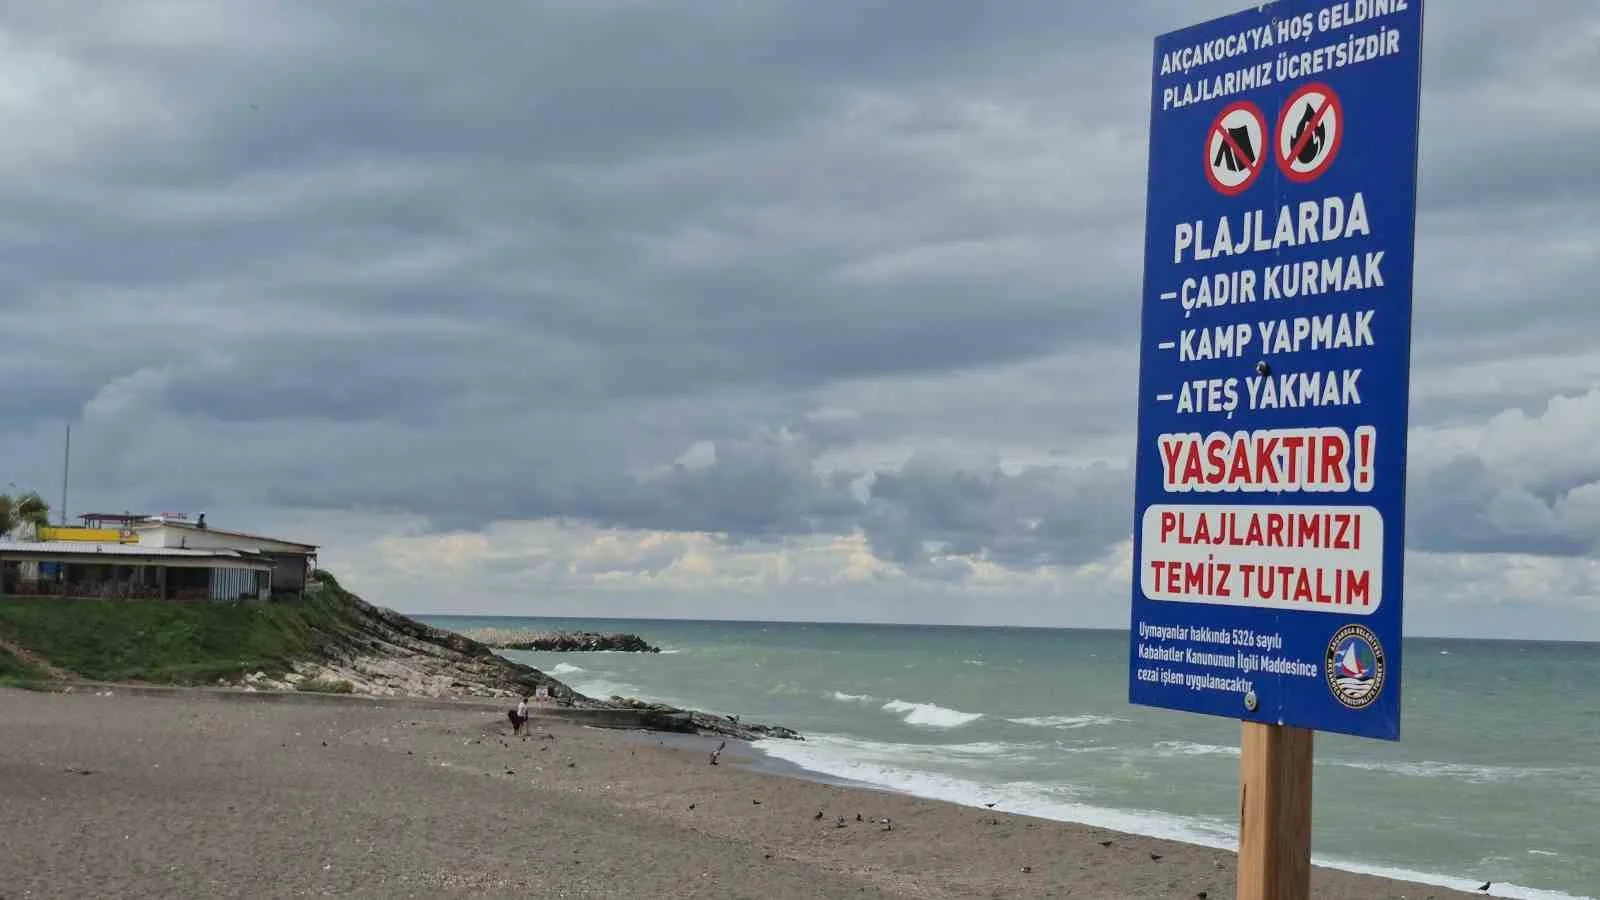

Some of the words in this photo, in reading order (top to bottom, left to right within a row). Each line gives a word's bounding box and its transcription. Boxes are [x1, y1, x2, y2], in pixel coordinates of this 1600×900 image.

[1160, 27, 1273, 75] AKÇAKOCA'YA
[1278, 12, 1313, 44] HOŞ
[1163, 62, 1272, 110] PLAJLARIMIZ
[1276, 26, 1400, 82] ÜCRETSİZDİR
[1174, 192, 1370, 264] PLAJLARDA
[1181, 270, 1256, 318] ÇADIR
[1263, 251, 1385, 300] KURMAK
[1179, 323, 1252, 362] KAMP
[1258, 310, 1375, 355] YAPMAK
[1176, 377, 1239, 419] ATEŞ
[1245, 368, 1362, 410] YAKMAK
[1160, 511, 1361, 550] PLAJLARIMIZI
[1151, 553, 1232, 597] TEMİZ
[1239, 564, 1370, 606] TUTALIM
[1138, 643, 1184, 662] Kabahatler
[1185, 647, 1235, 668] Kanununun
[1260, 655, 1318, 678] Maddesince
[1139, 621, 1189, 641] Uymayanlar
[1190, 624, 1231, 644] hakkında
[1232, 629, 1255, 647] 5326
[1256, 633, 1282, 651] sayılı
[1137, 667, 1160, 682] cezai
[1160, 669, 1184, 686] işlem
